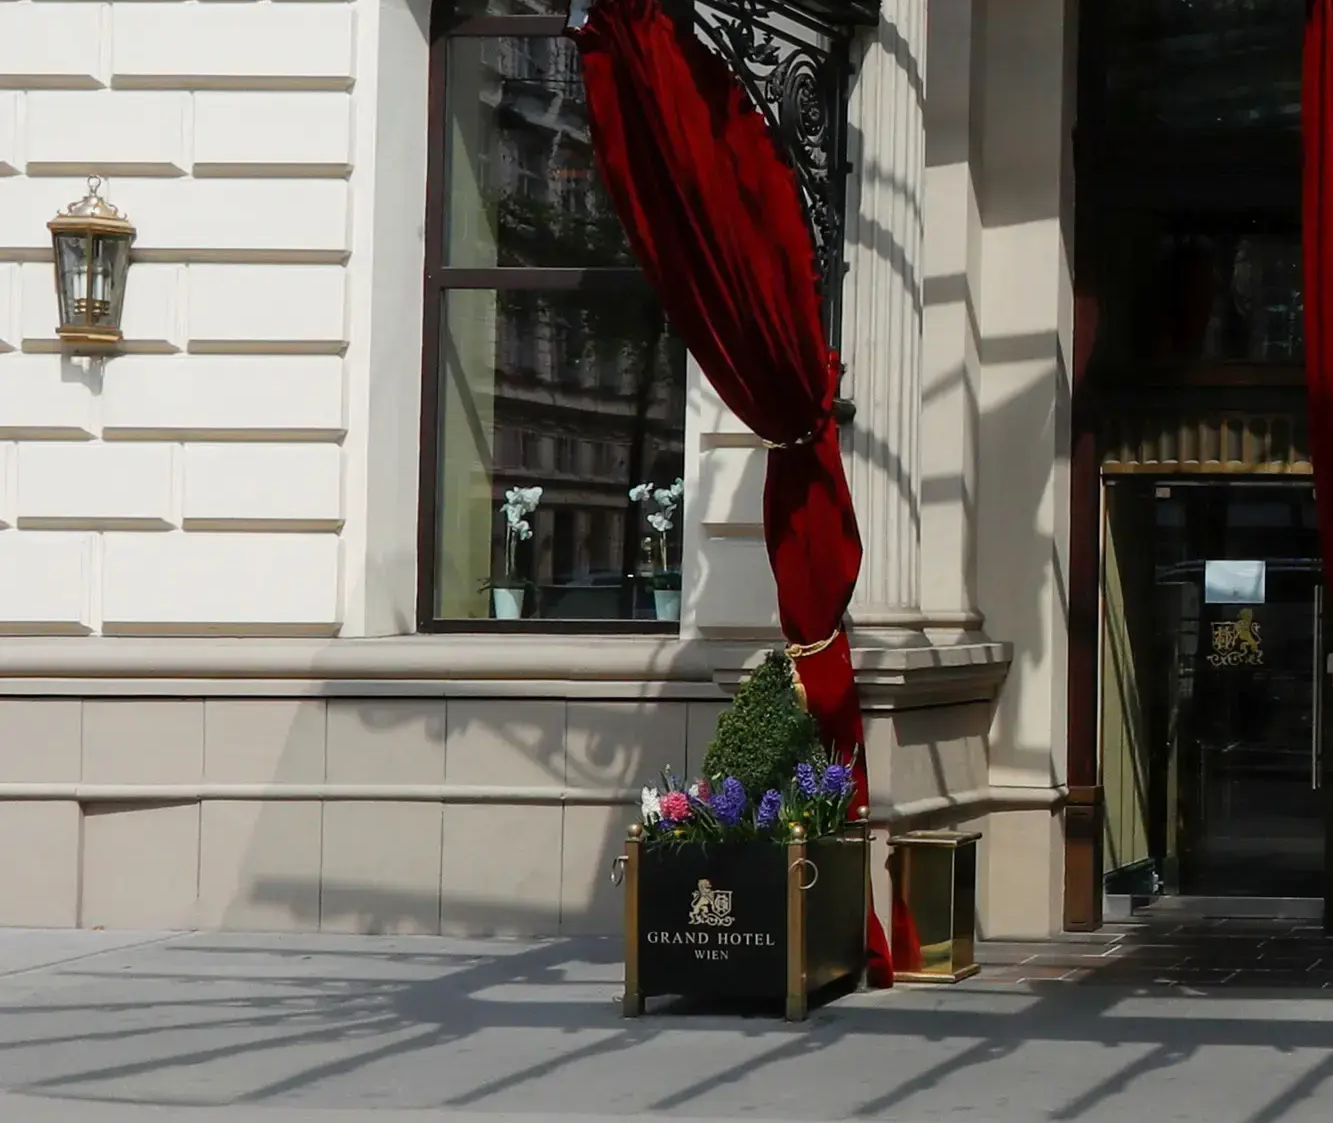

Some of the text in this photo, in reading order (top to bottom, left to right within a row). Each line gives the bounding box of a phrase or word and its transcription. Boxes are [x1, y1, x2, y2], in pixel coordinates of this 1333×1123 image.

[647, 931, 776, 946] GRAND HOTEL
[694, 949, 729, 960] WIEN
